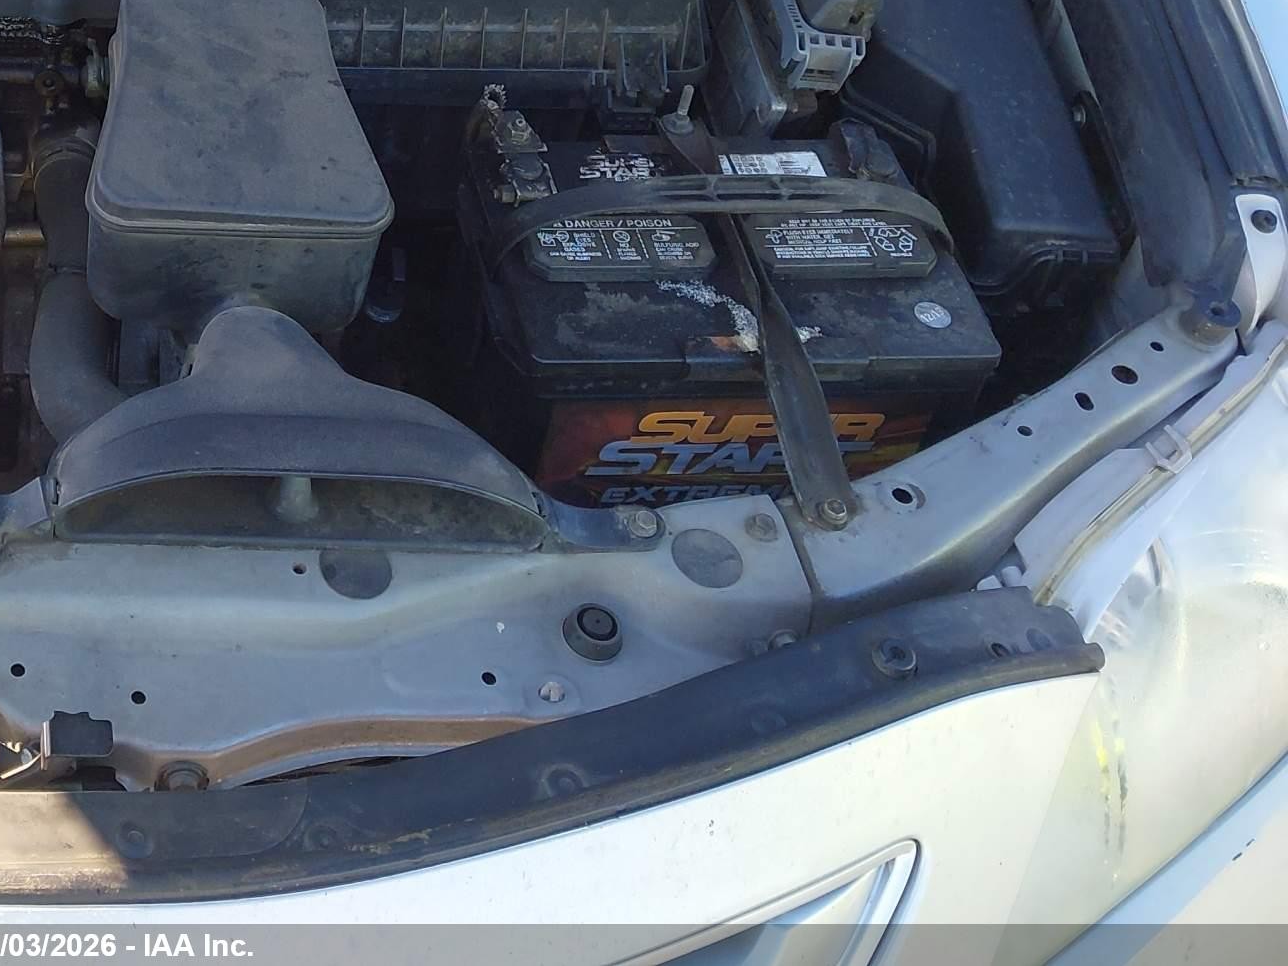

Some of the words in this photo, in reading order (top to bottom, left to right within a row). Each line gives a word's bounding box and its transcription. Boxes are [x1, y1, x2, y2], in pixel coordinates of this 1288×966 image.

[564, 219, 613, 228] DANGER
[626, 218, 673, 228] POISON
[631, 411, 885, 444] SUPR
